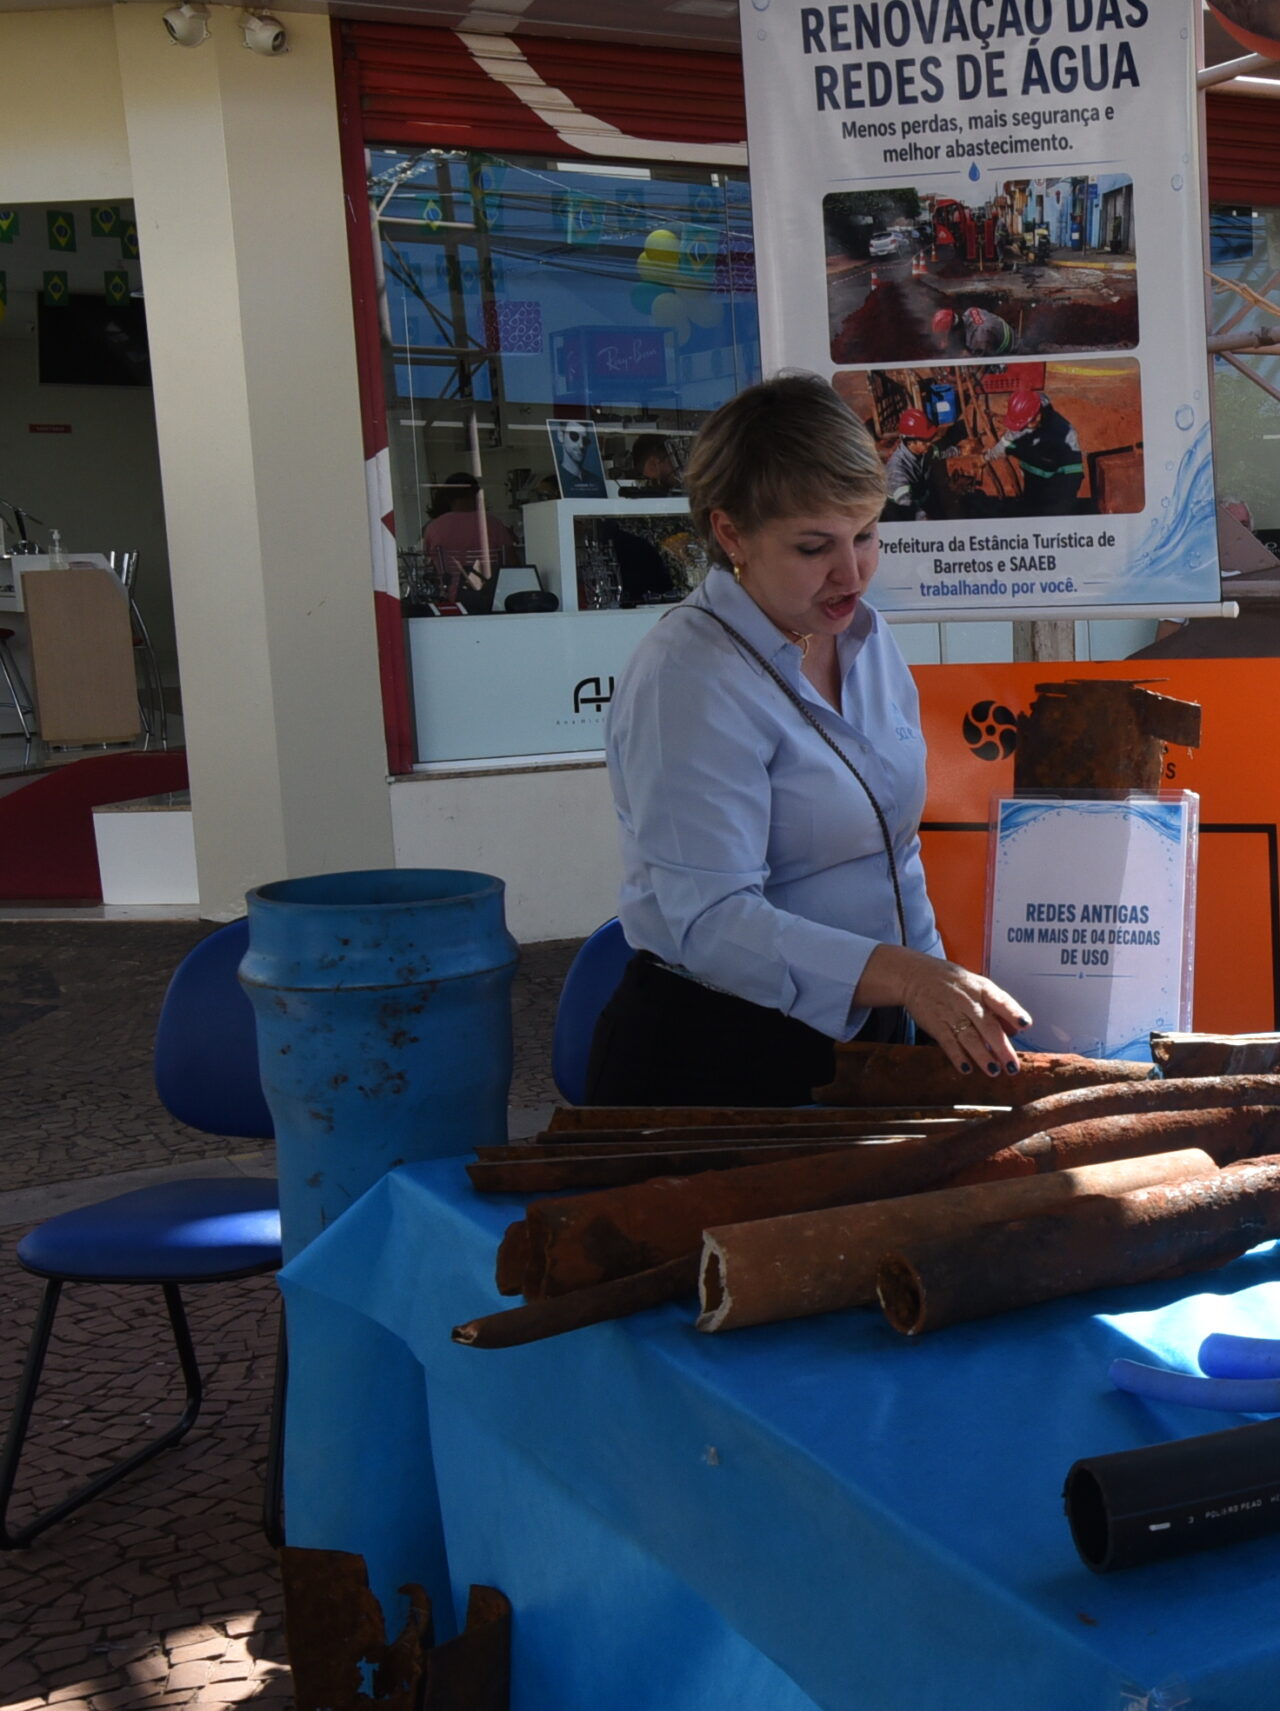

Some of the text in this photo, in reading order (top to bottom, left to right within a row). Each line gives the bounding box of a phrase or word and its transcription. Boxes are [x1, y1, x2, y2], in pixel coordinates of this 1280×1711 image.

[1066, 0, 1149, 33] DAS
[814, 37, 1140, 111] REDES DE ÁGUA
[842, 104, 1115, 140] Menos perdas, mais segurança e
[883, 133, 1074, 163] melhor abastecimento.
[948, 536, 965, 552] da
[969, 535, 1029, 551] Estância
[1032, 532, 1094, 549] Turística
[1097, 531, 1116, 548] de
[933, 555, 1057, 575] Barretos e SAAEB
[920, 577, 1078, 598] trabalhando por você.
[1026, 903, 1149, 924] REDES ANTIGAS
[1007, 926, 1161, 945] COM MAIS DE 04 DÉCADAS
[1060, 949, 1109, 966] DE USO
